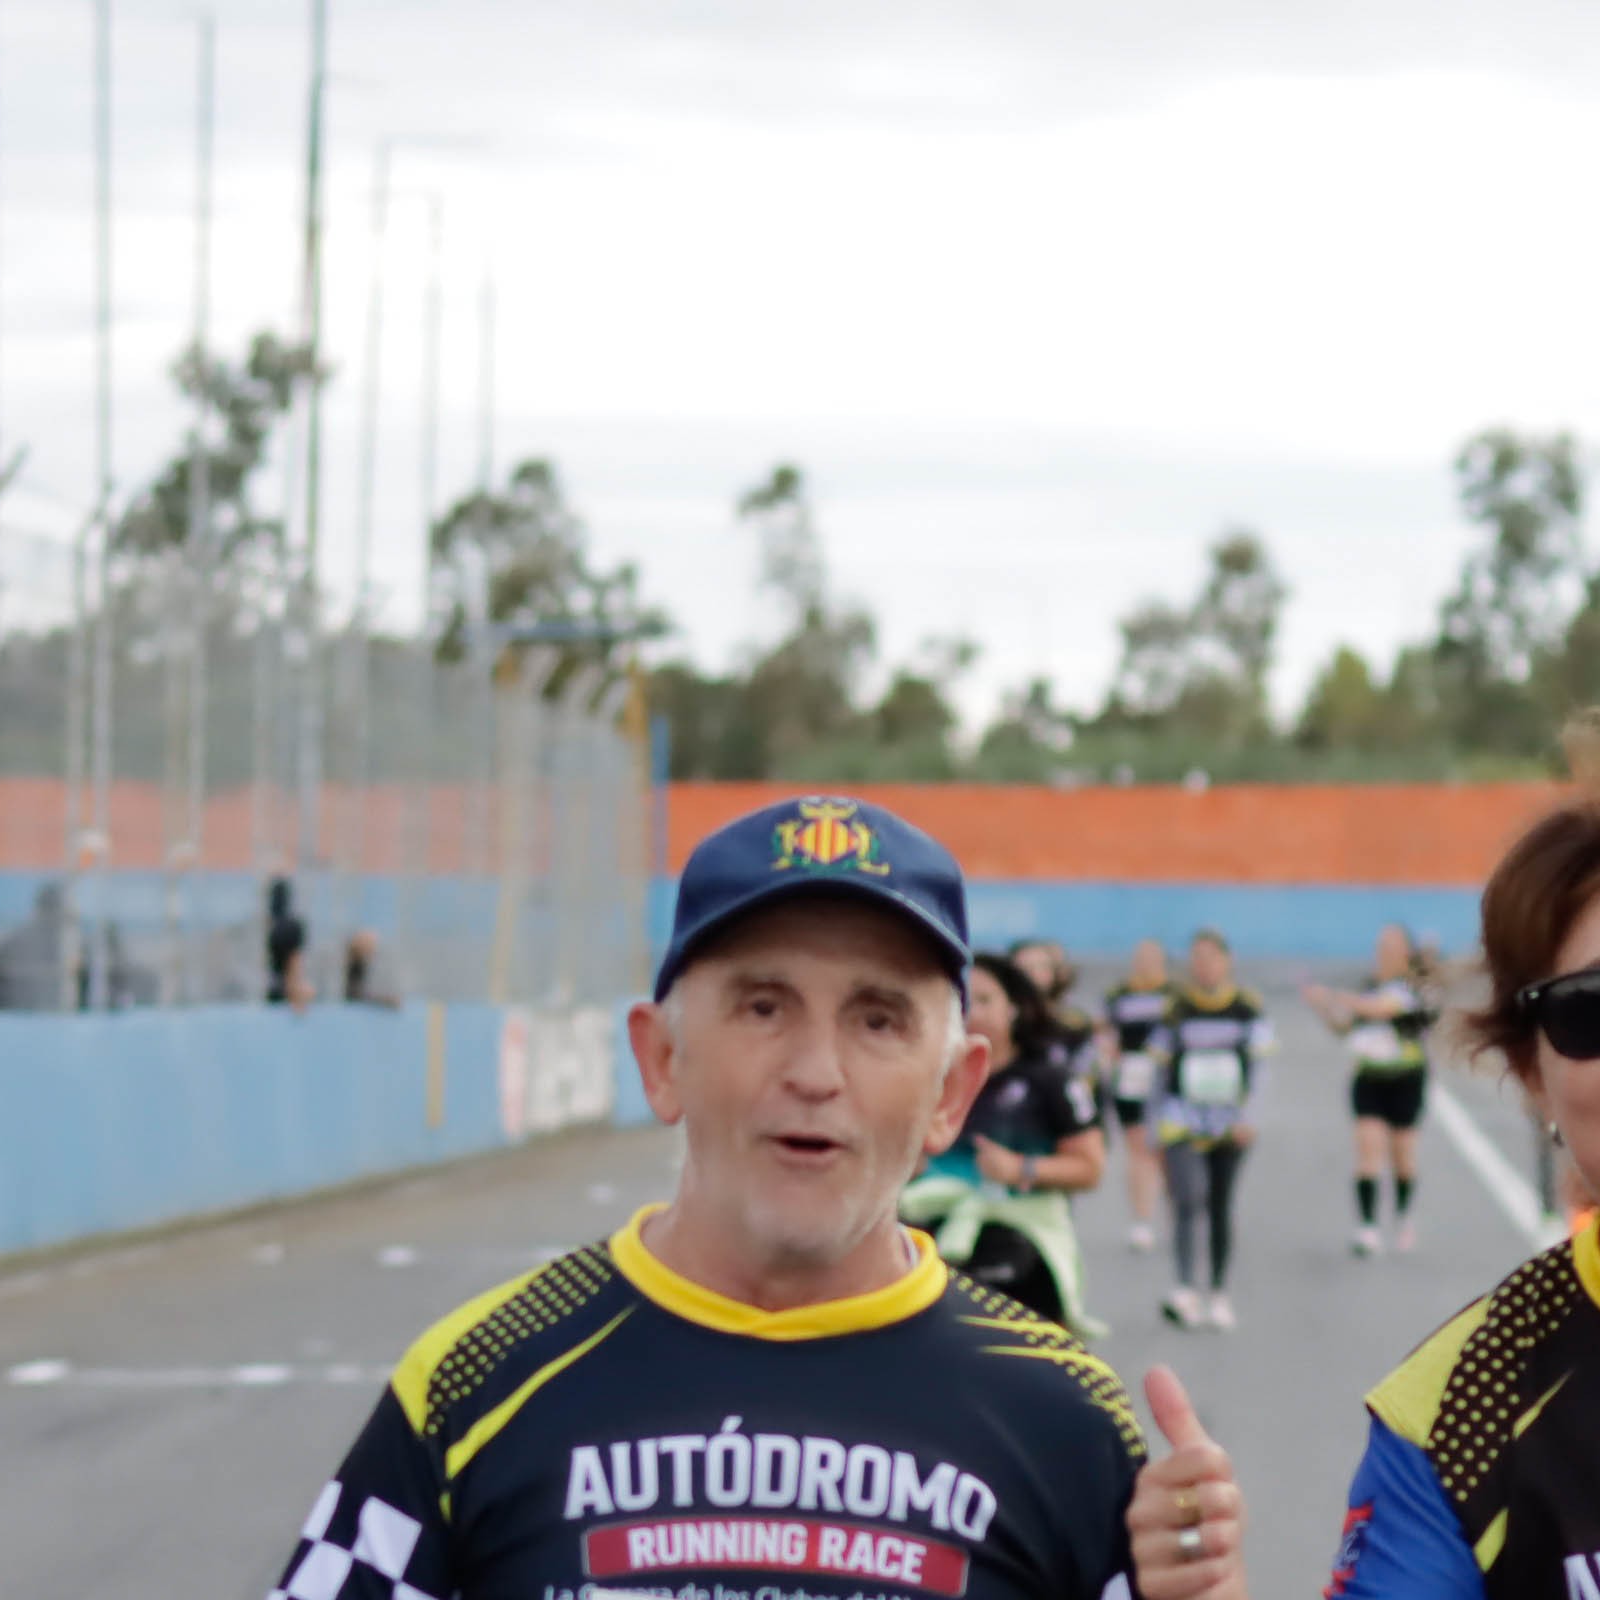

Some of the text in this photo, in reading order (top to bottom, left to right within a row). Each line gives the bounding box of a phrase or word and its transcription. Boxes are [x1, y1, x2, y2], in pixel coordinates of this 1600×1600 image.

[563, 1415, 998, 1542] AUTÓDROMO
[627, 1521, 927, 1584] RUNNING RACE
